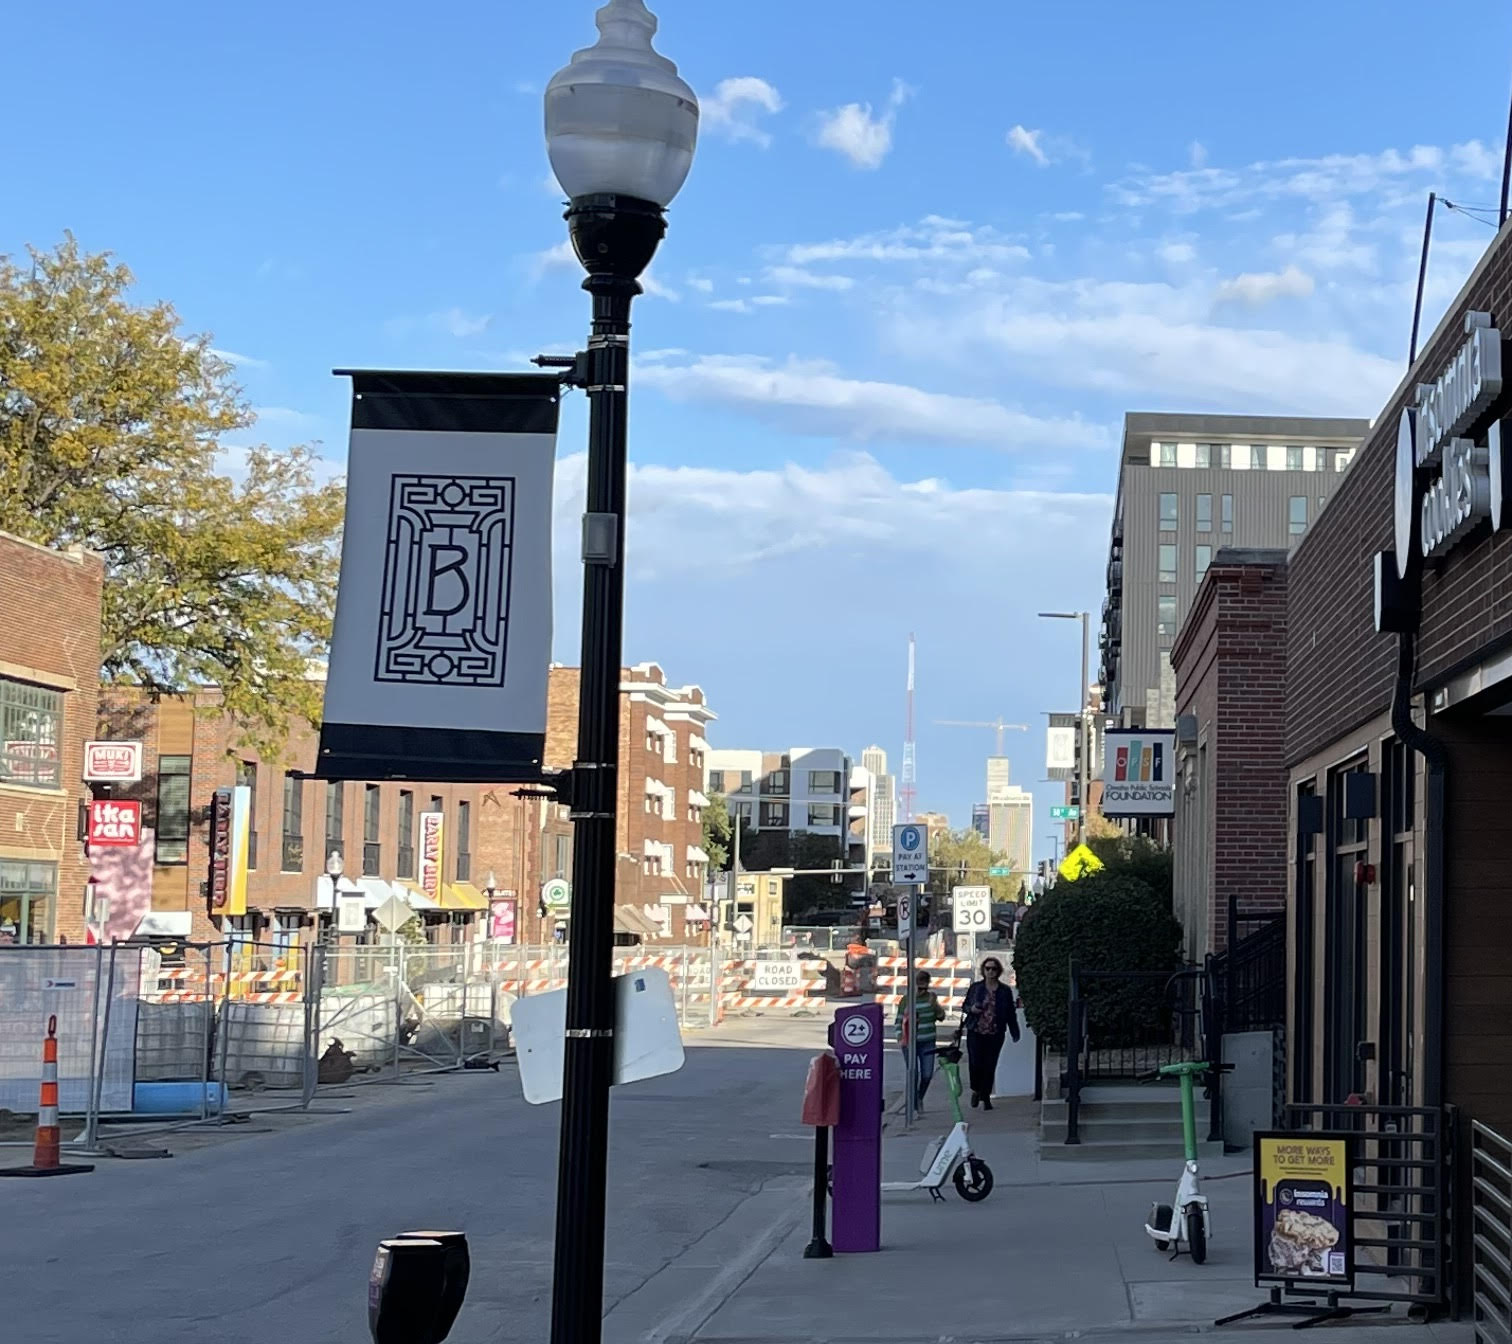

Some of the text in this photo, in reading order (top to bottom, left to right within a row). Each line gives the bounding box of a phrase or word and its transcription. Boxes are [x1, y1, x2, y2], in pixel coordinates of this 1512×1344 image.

[423, 543, 470, 617] B
[95, 750, 129, 760] MUKI
[1106, 791, 1172, 801] FOUNDATION
[94, 803, 135, 823] ika
[898, 853, 911, 861] PAY
[896, 864, 925, 872] STATION
[958, 890, 987, 898] SPEED
[960, 899, 984, 907] LIMIT
[959, 909, 986, 926] 30
[764, 965, 793, 974] ROAD
[758, 976, 798, 986] CLOSED
[844, 1053, 868, 1065] PAY
[840, 1068, 872, 1080] HERE
[1277, 1145, 1331, 1156] MORE WAYS
[1274, 1155, 1335, 1166] TO GET MORE
